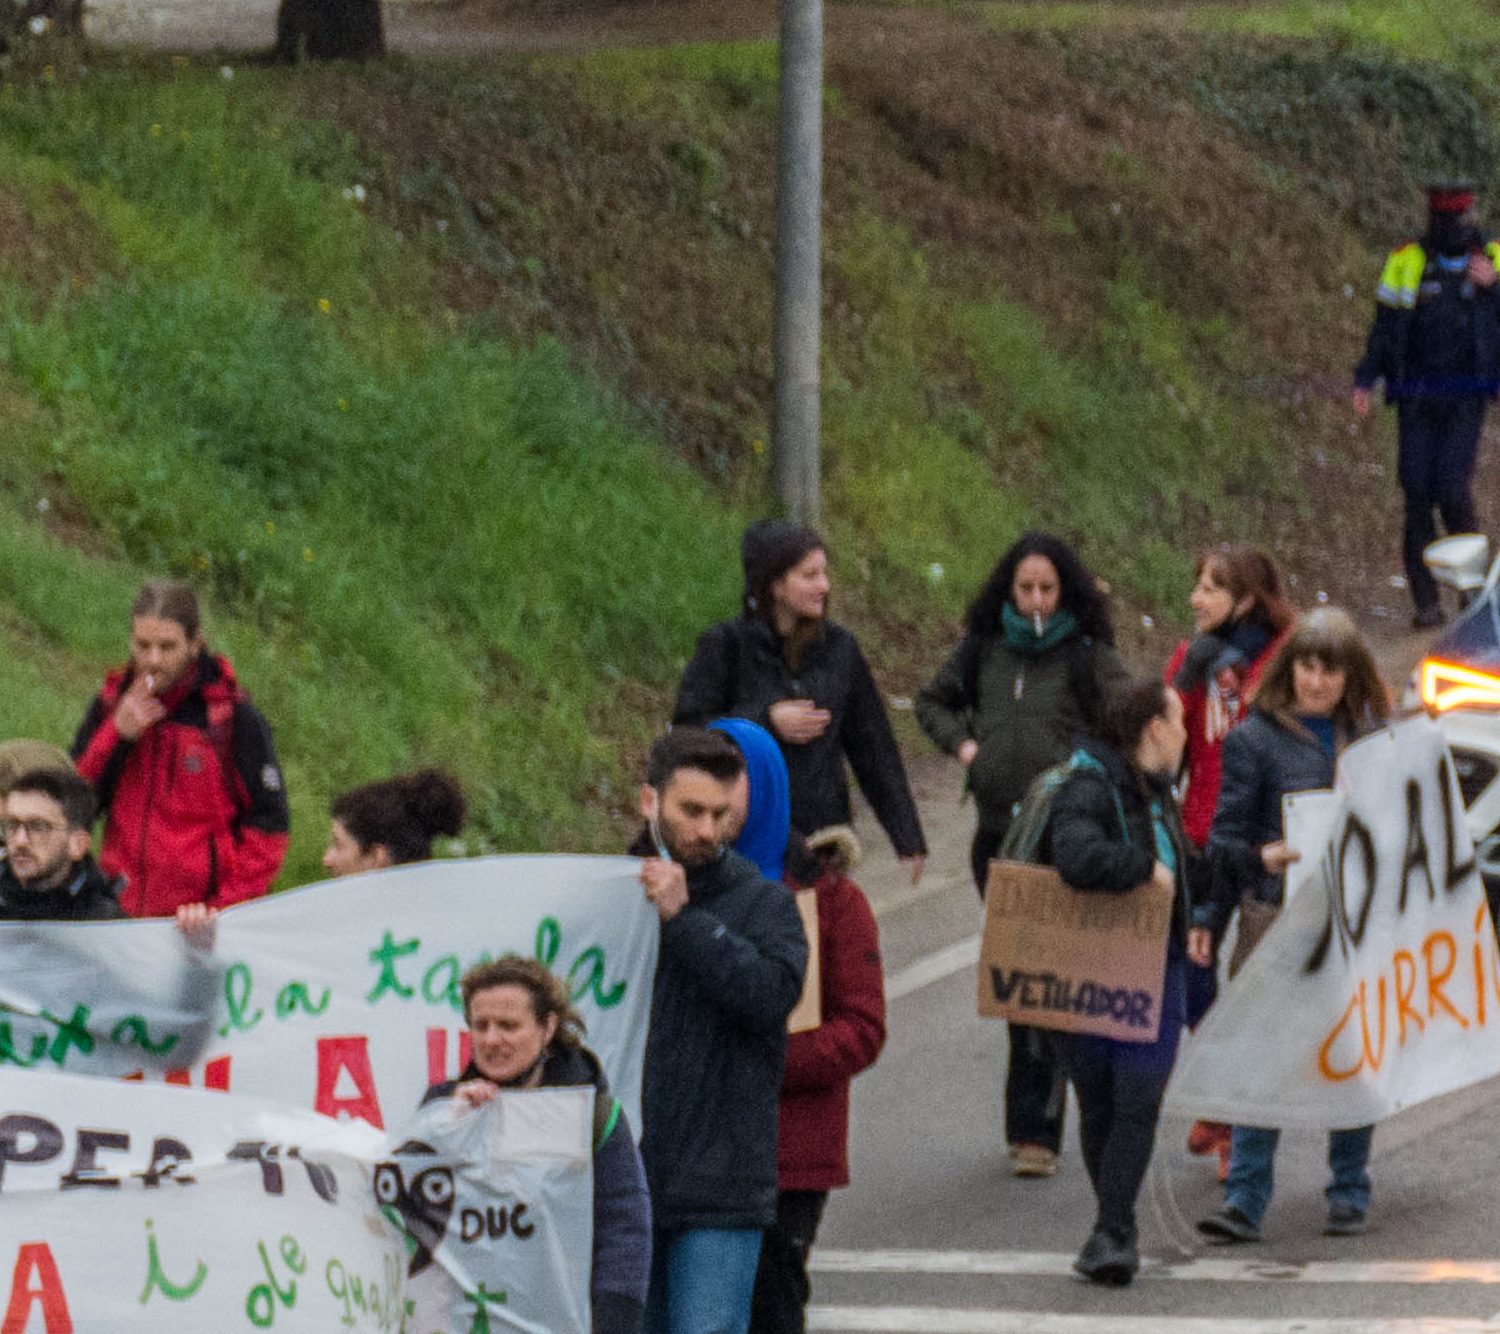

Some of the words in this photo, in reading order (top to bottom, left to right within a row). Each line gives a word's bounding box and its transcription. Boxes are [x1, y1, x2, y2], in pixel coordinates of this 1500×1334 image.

[1398, 753, 1478, 915] AL
[218, 962, 331, 1038] la
[366, 915, 628, 1011] tala
[246, 1232, 308, 1328] de
